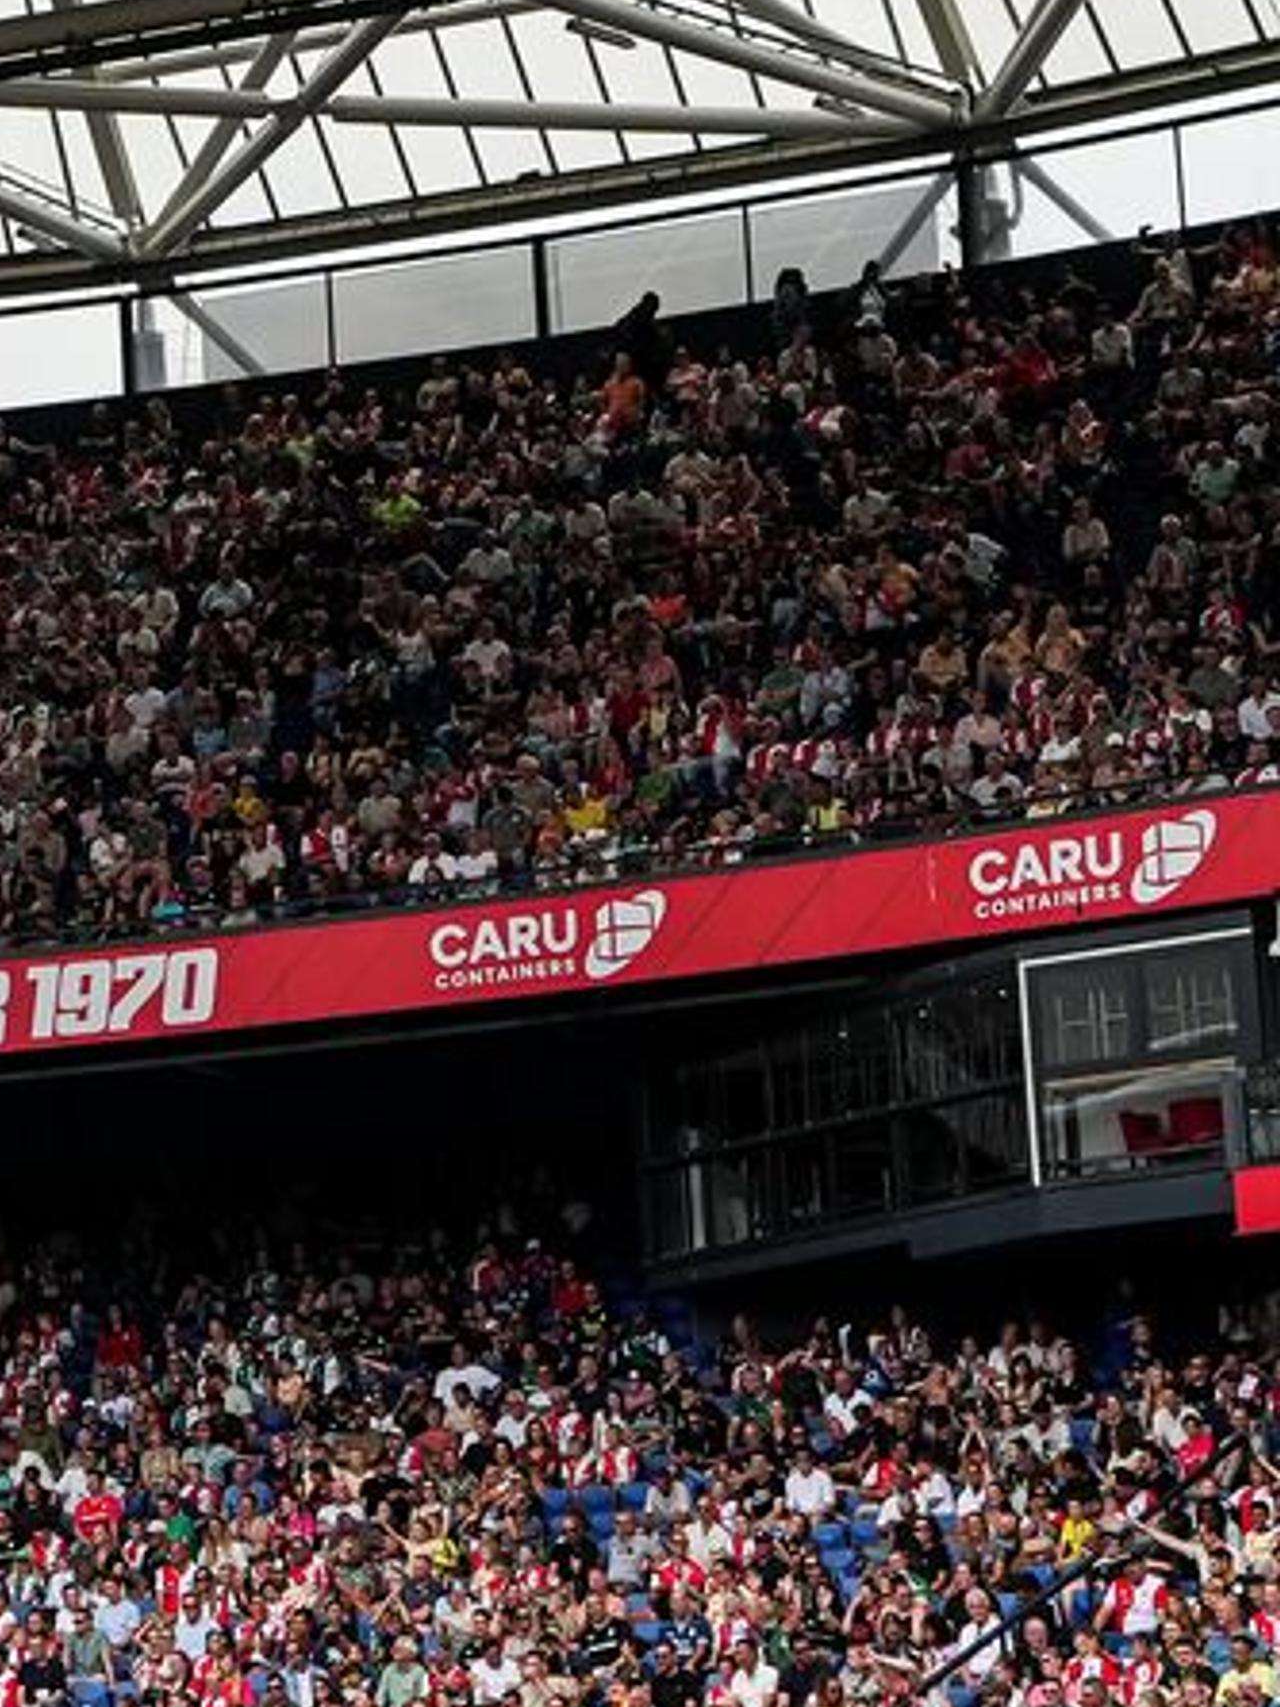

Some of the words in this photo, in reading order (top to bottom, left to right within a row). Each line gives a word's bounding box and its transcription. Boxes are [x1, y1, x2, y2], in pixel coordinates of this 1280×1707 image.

[969, 832, 1122, 894] CARU
[973, 882, 1121, 919] CONTAINERS
[430, 909, 577, 967] CARU
[26, 949, 218, 1039] 1970
[434, 958, 576, 989] CONTAINERS
